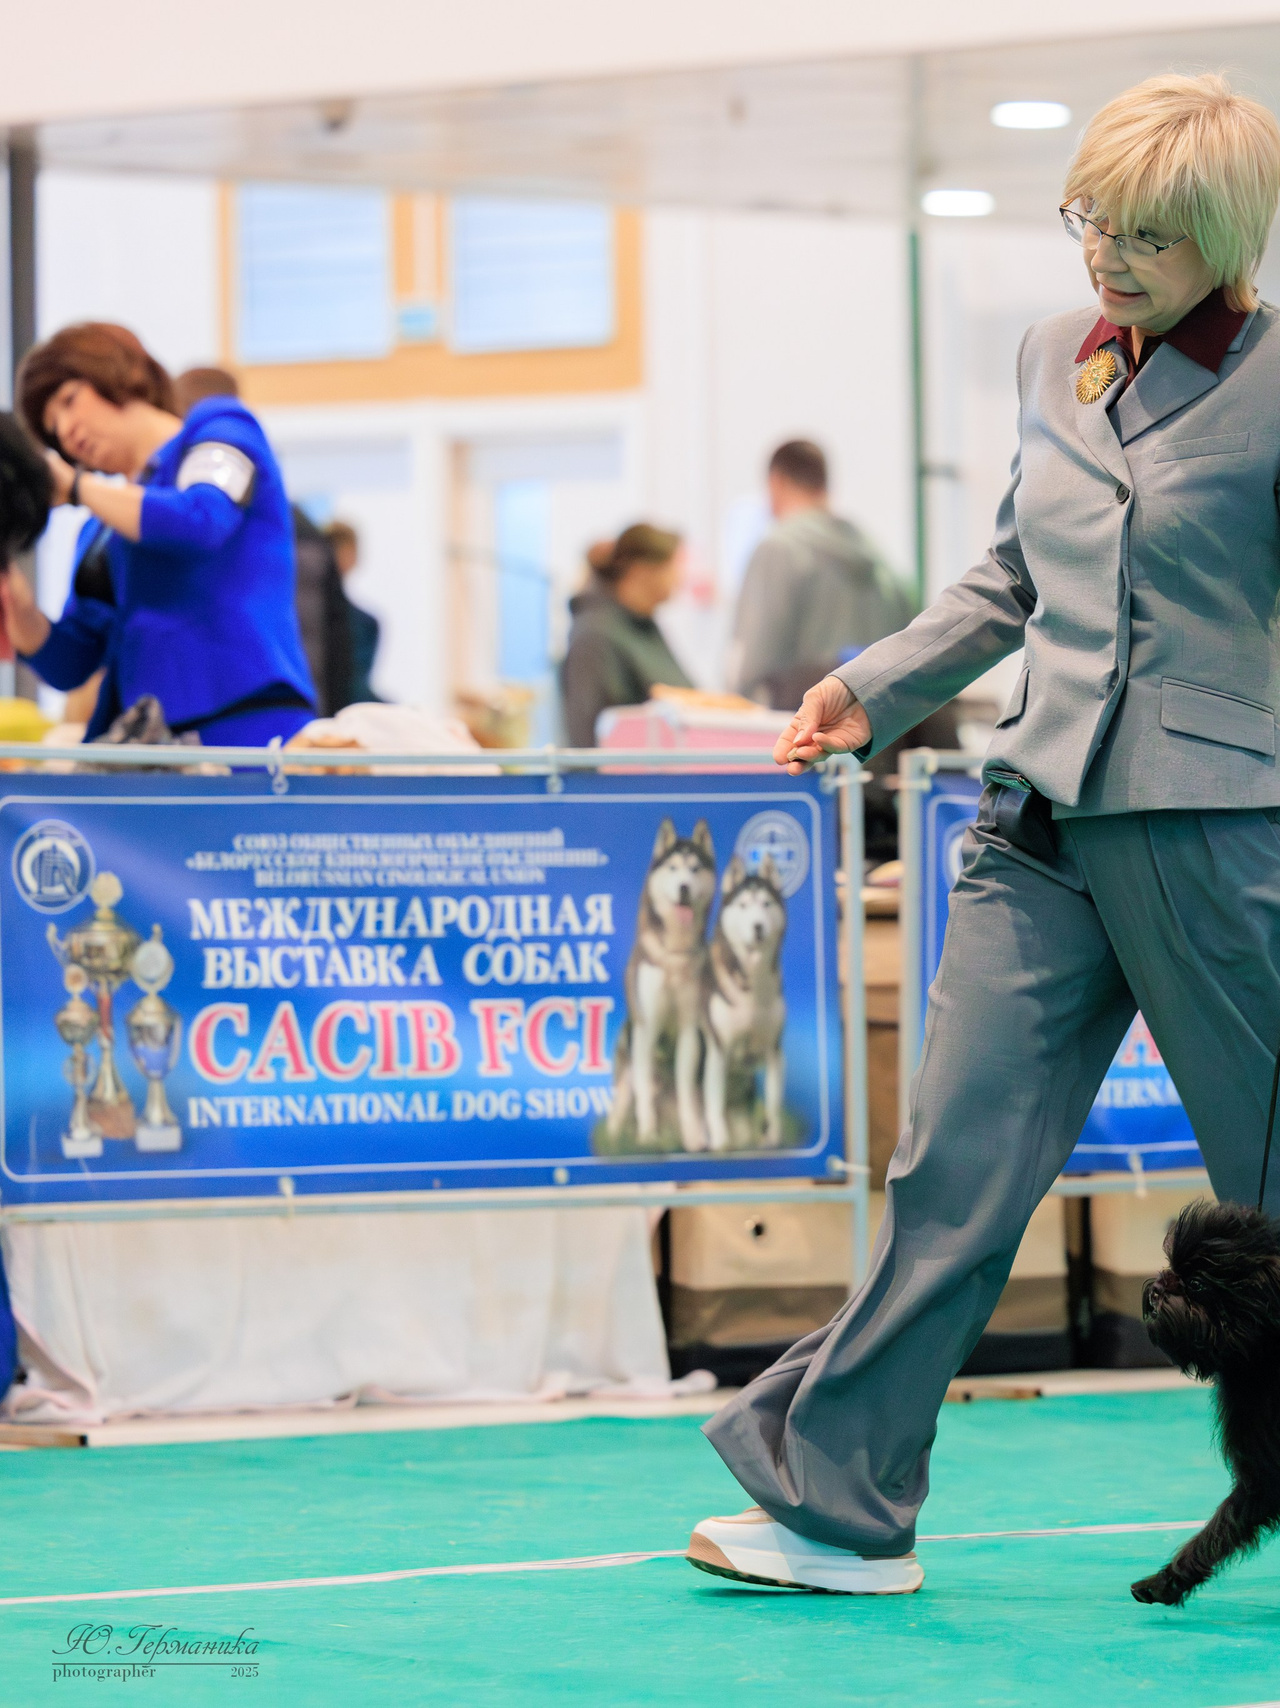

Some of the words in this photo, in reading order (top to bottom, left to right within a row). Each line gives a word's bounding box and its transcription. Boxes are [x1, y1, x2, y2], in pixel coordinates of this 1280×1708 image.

[188, 893, 615, 944] МЕЖДУНАРОДНАЯ
[202, 944, 443, 989] ВЫСТАВКА
[462, 941, 611, 986] СОБАК
[188, 999, 462, 1085] CACIB
[470, 996, 615, 1077] FCI
[188, 1091, 448, 1128] INTERNATIONAL
[452, 1088, 521, 1121] DOG
[525, 1086, 616, 1119] SHOW
